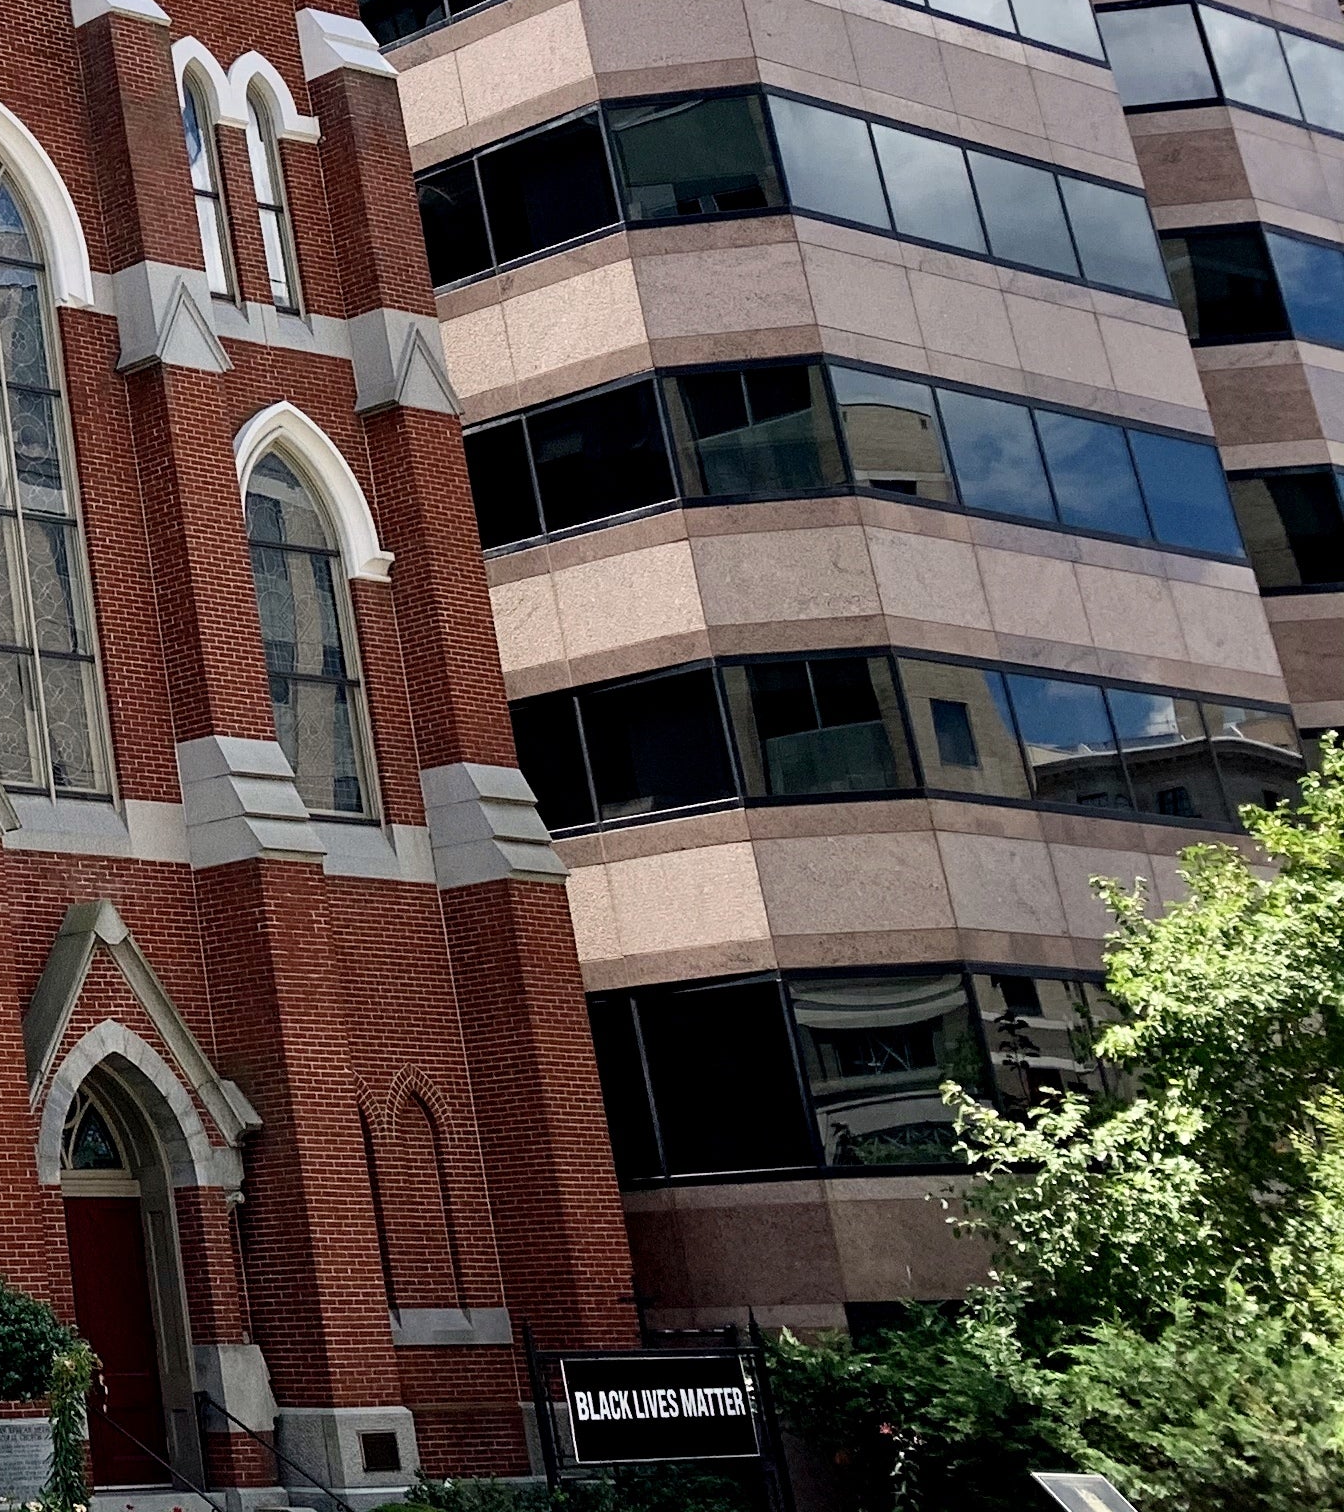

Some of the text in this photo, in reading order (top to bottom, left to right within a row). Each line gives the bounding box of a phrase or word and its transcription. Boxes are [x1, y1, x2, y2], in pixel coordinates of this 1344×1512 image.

[574, 1387, 746, 1421] BLACK LIVES MATTER
